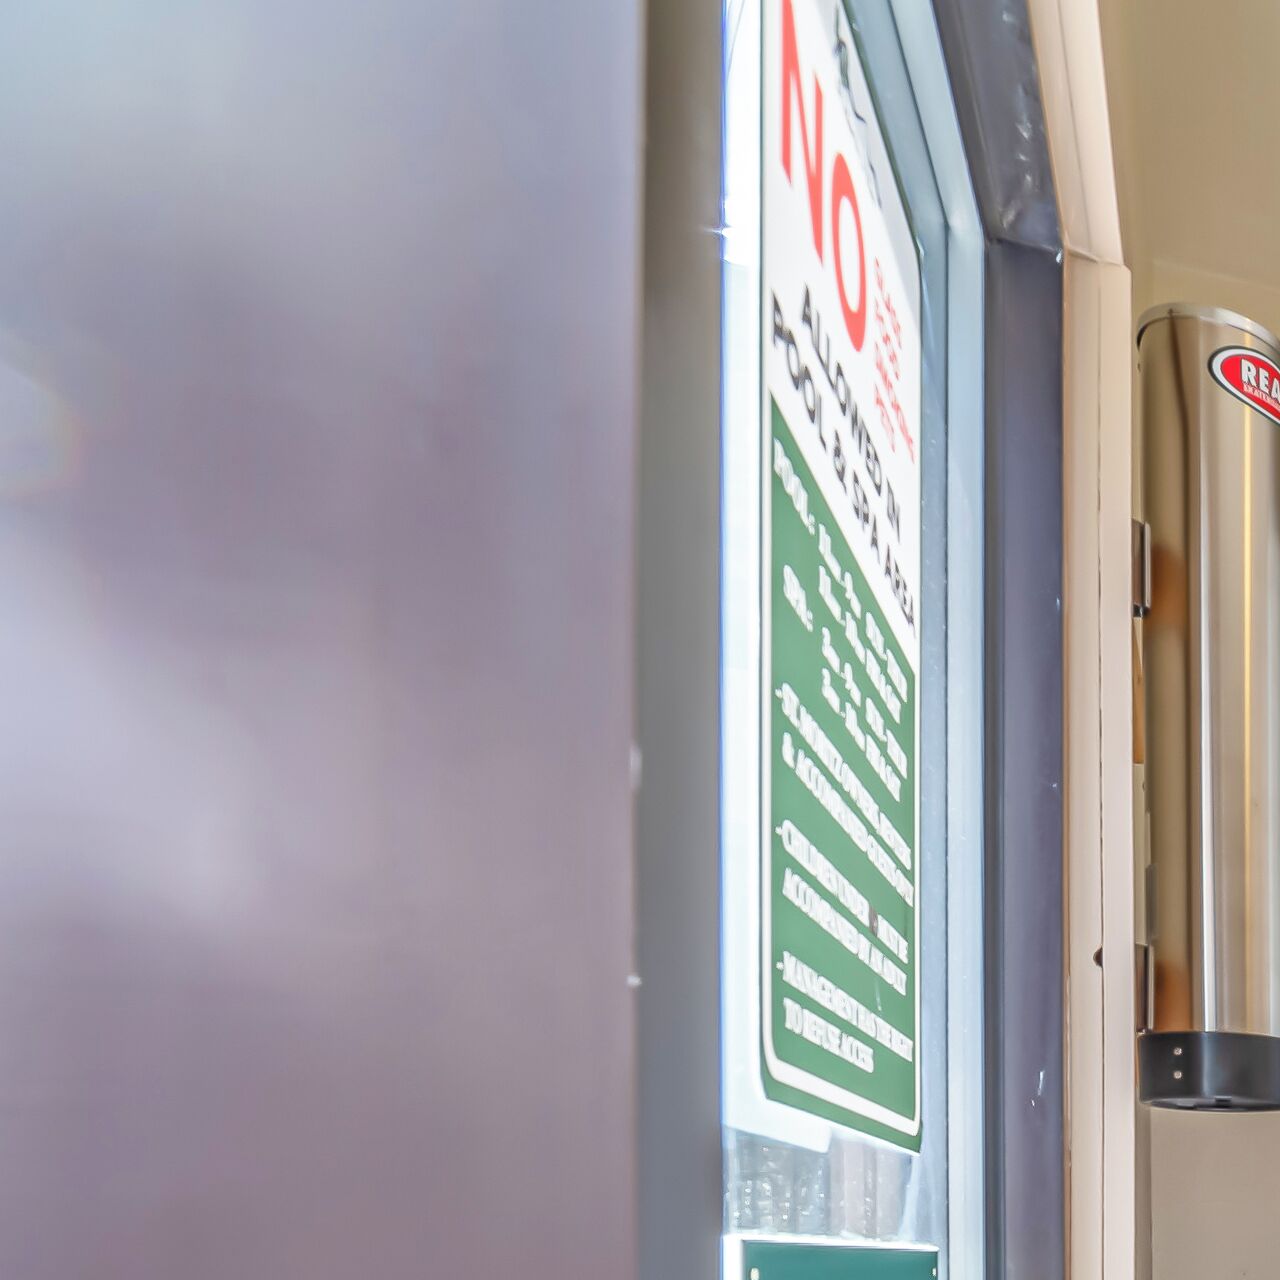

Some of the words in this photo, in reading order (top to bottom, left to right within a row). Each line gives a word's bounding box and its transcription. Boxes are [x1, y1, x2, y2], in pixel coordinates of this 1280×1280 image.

[781, 0, 867, 351] NO
[772, 292, 826, 451] POOL
[853, 471, 879, 556] SPA
[884, 544, 915, 637] AREA
[802, 286, 882, 496] ALLOWED
